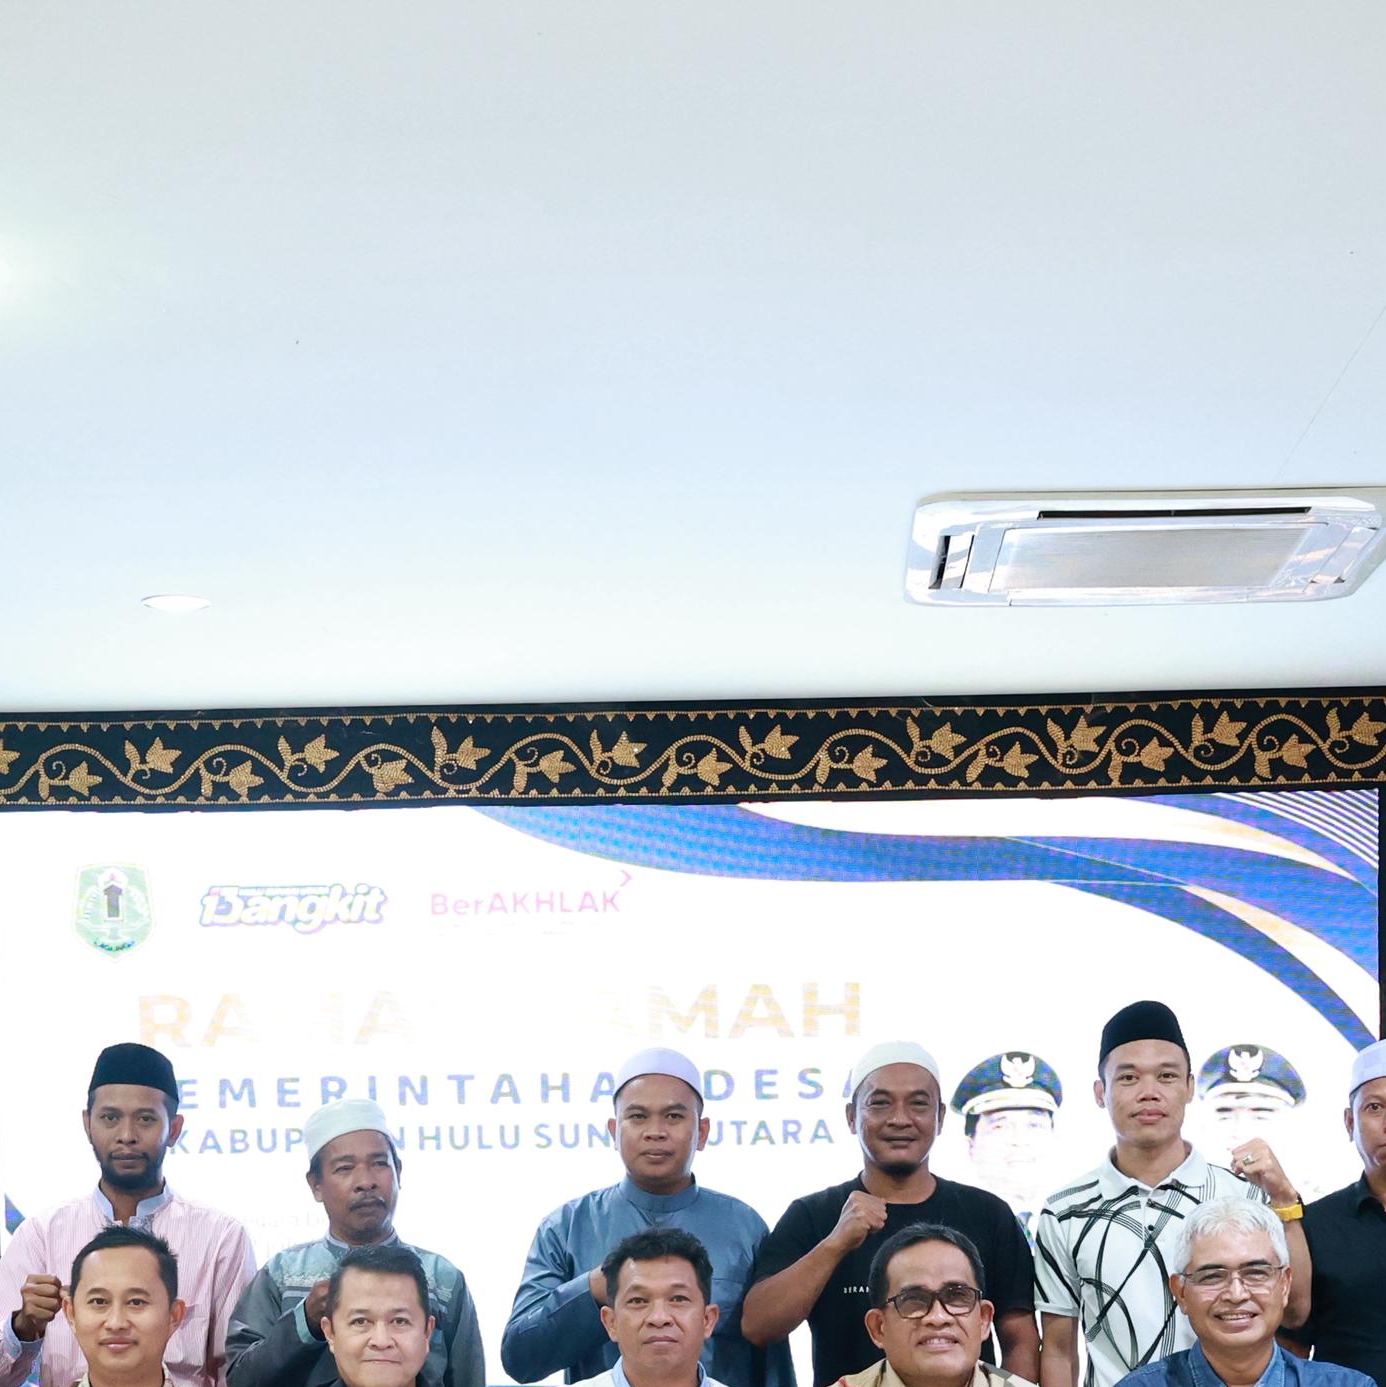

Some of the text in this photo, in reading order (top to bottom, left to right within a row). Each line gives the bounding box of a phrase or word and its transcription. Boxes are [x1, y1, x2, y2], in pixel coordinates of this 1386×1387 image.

[430, 889, 621, 916] BerAKHLAK
[176, 1072, 617, 1109] EMERINTAHA
[418, 1125, 520, 1151] HULU
[534, 1122, 611, 1149] SUN
